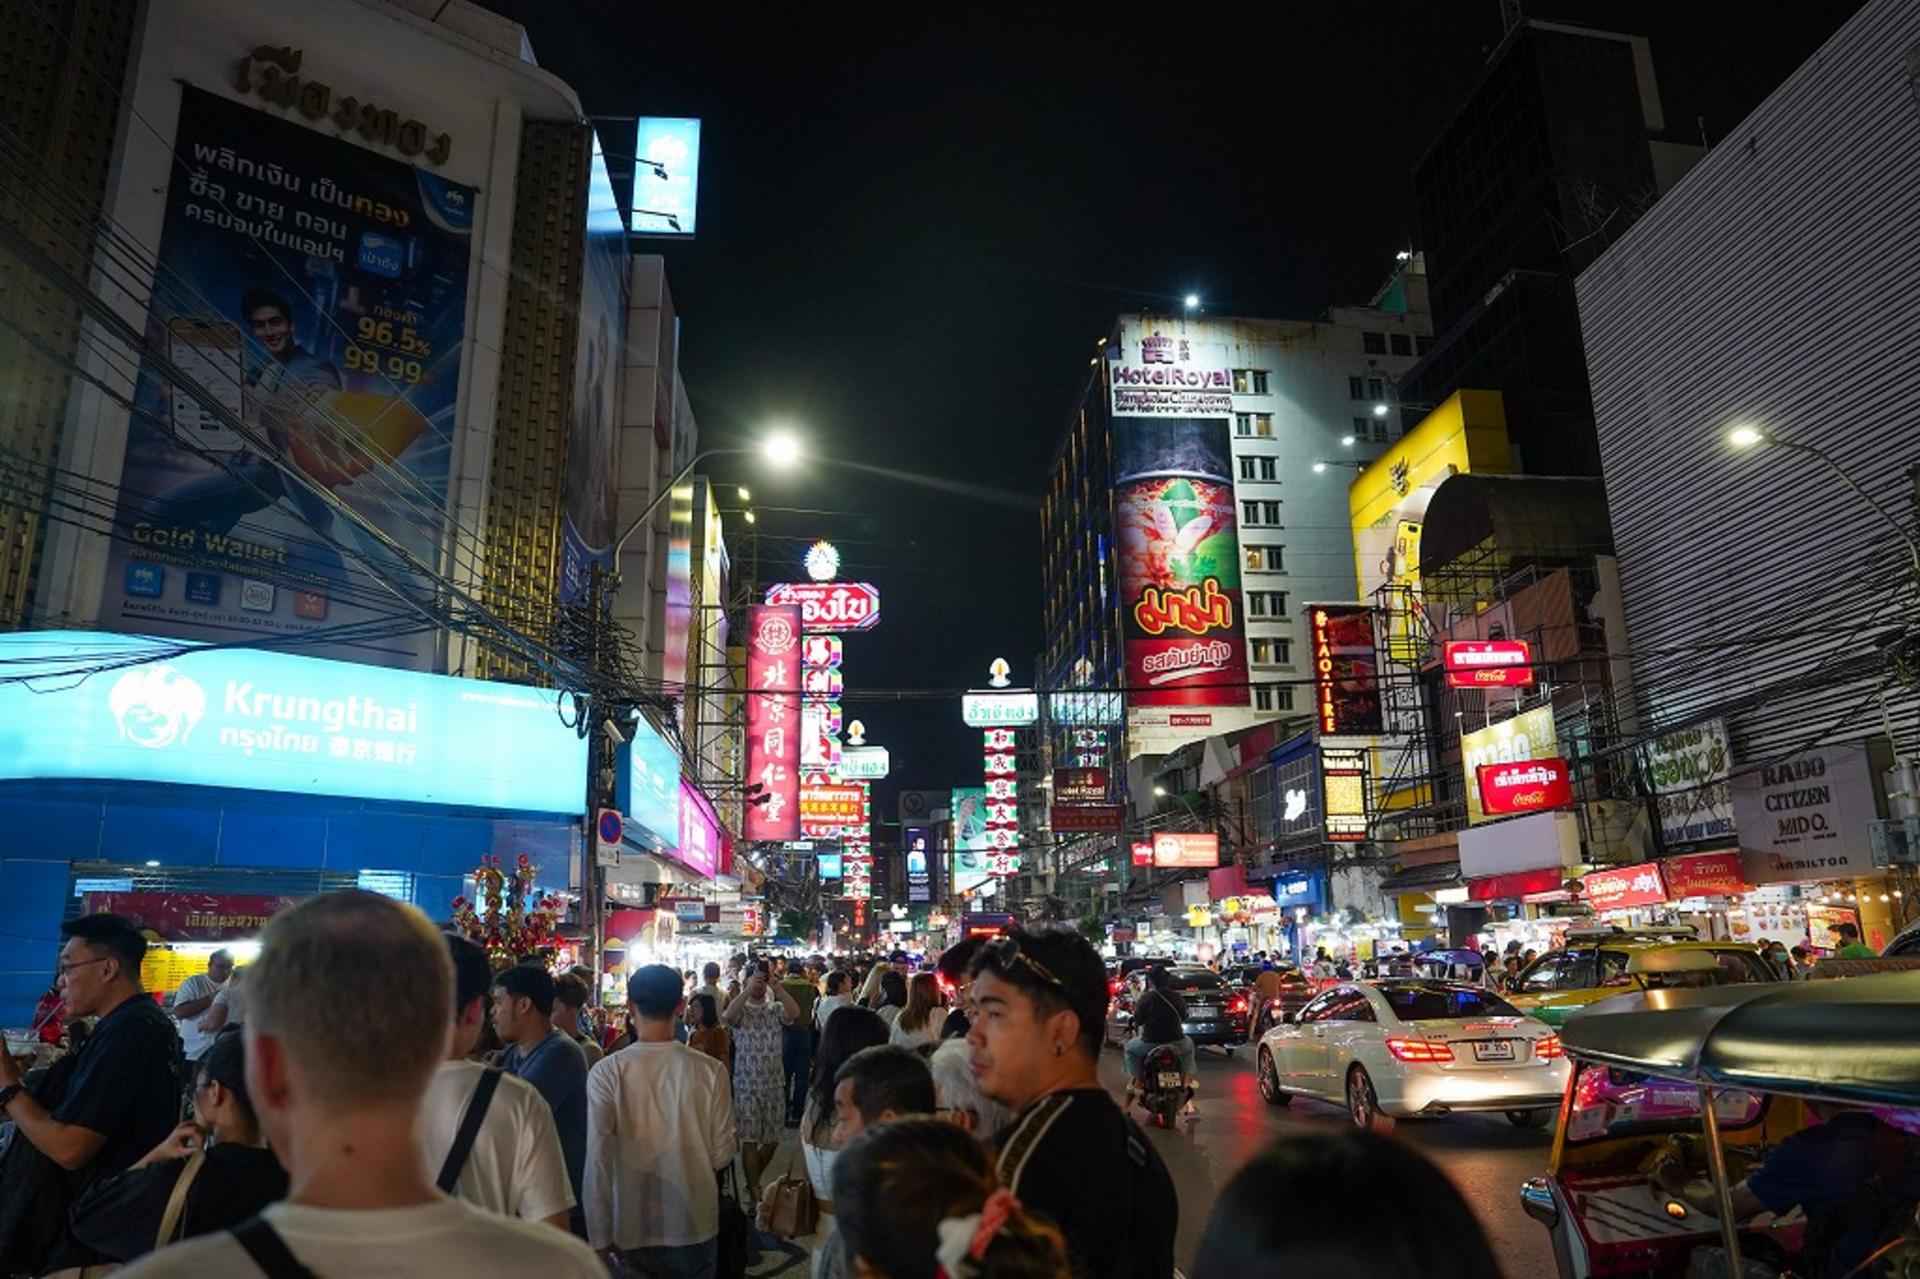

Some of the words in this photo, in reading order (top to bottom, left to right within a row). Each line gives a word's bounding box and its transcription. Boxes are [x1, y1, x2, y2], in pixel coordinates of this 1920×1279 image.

[193, 141, 301, 194] พลิกเงิน
[187, 167, 228, 203] ซื้อ
[235, 192, 286, 221] ขาย
[357, 315, 432, 356] 96.5%
[132, 521, 196, 551] Gold
[203, 532, 290, 566] Wallet
[1135, 578, 1232, 634] มาม่า
[223, 681, 418, 734] Krungthai
[220, 713, 319, 757] กรุงไทย
[760, 659, 787, 822] 北京同仁堂
[1760, 755, 1826, 788] RADO
[1764, 785, 1830, 813] CITIZEN
